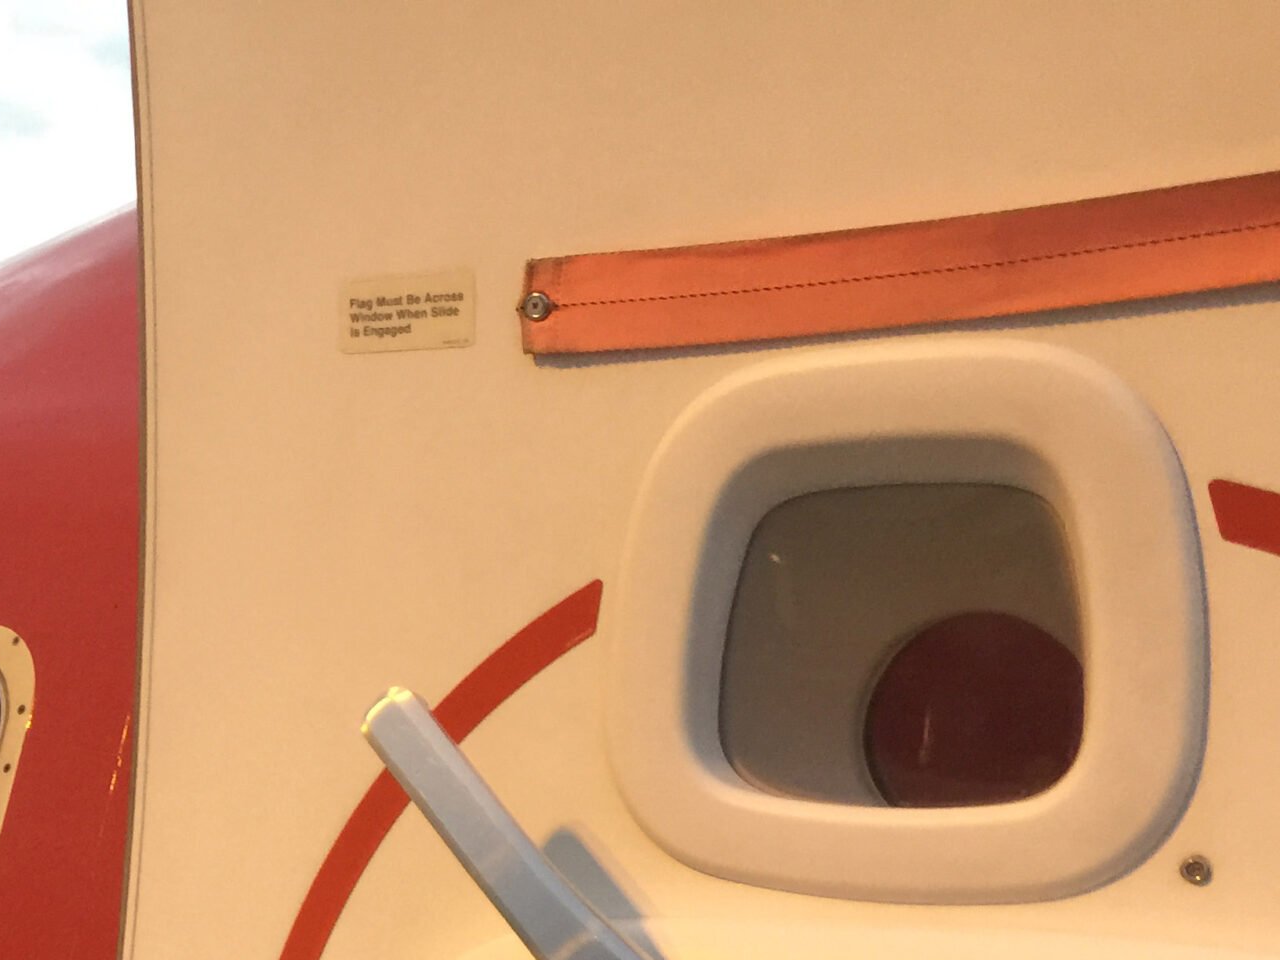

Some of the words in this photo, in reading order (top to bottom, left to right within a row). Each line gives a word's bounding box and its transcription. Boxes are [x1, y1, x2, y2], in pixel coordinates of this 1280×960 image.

[349, 298, 373, 311] Flag
[375, 295, 403, 307] Must
[406, 294, 421, 305] Be
[424, 292, 464, 303] Across
[349, 312, 393, 323] Window
[396, 309, 428, 320] When
[431, 306, 460, 318] Slide
[363, 323, 412, 338] Engaged
